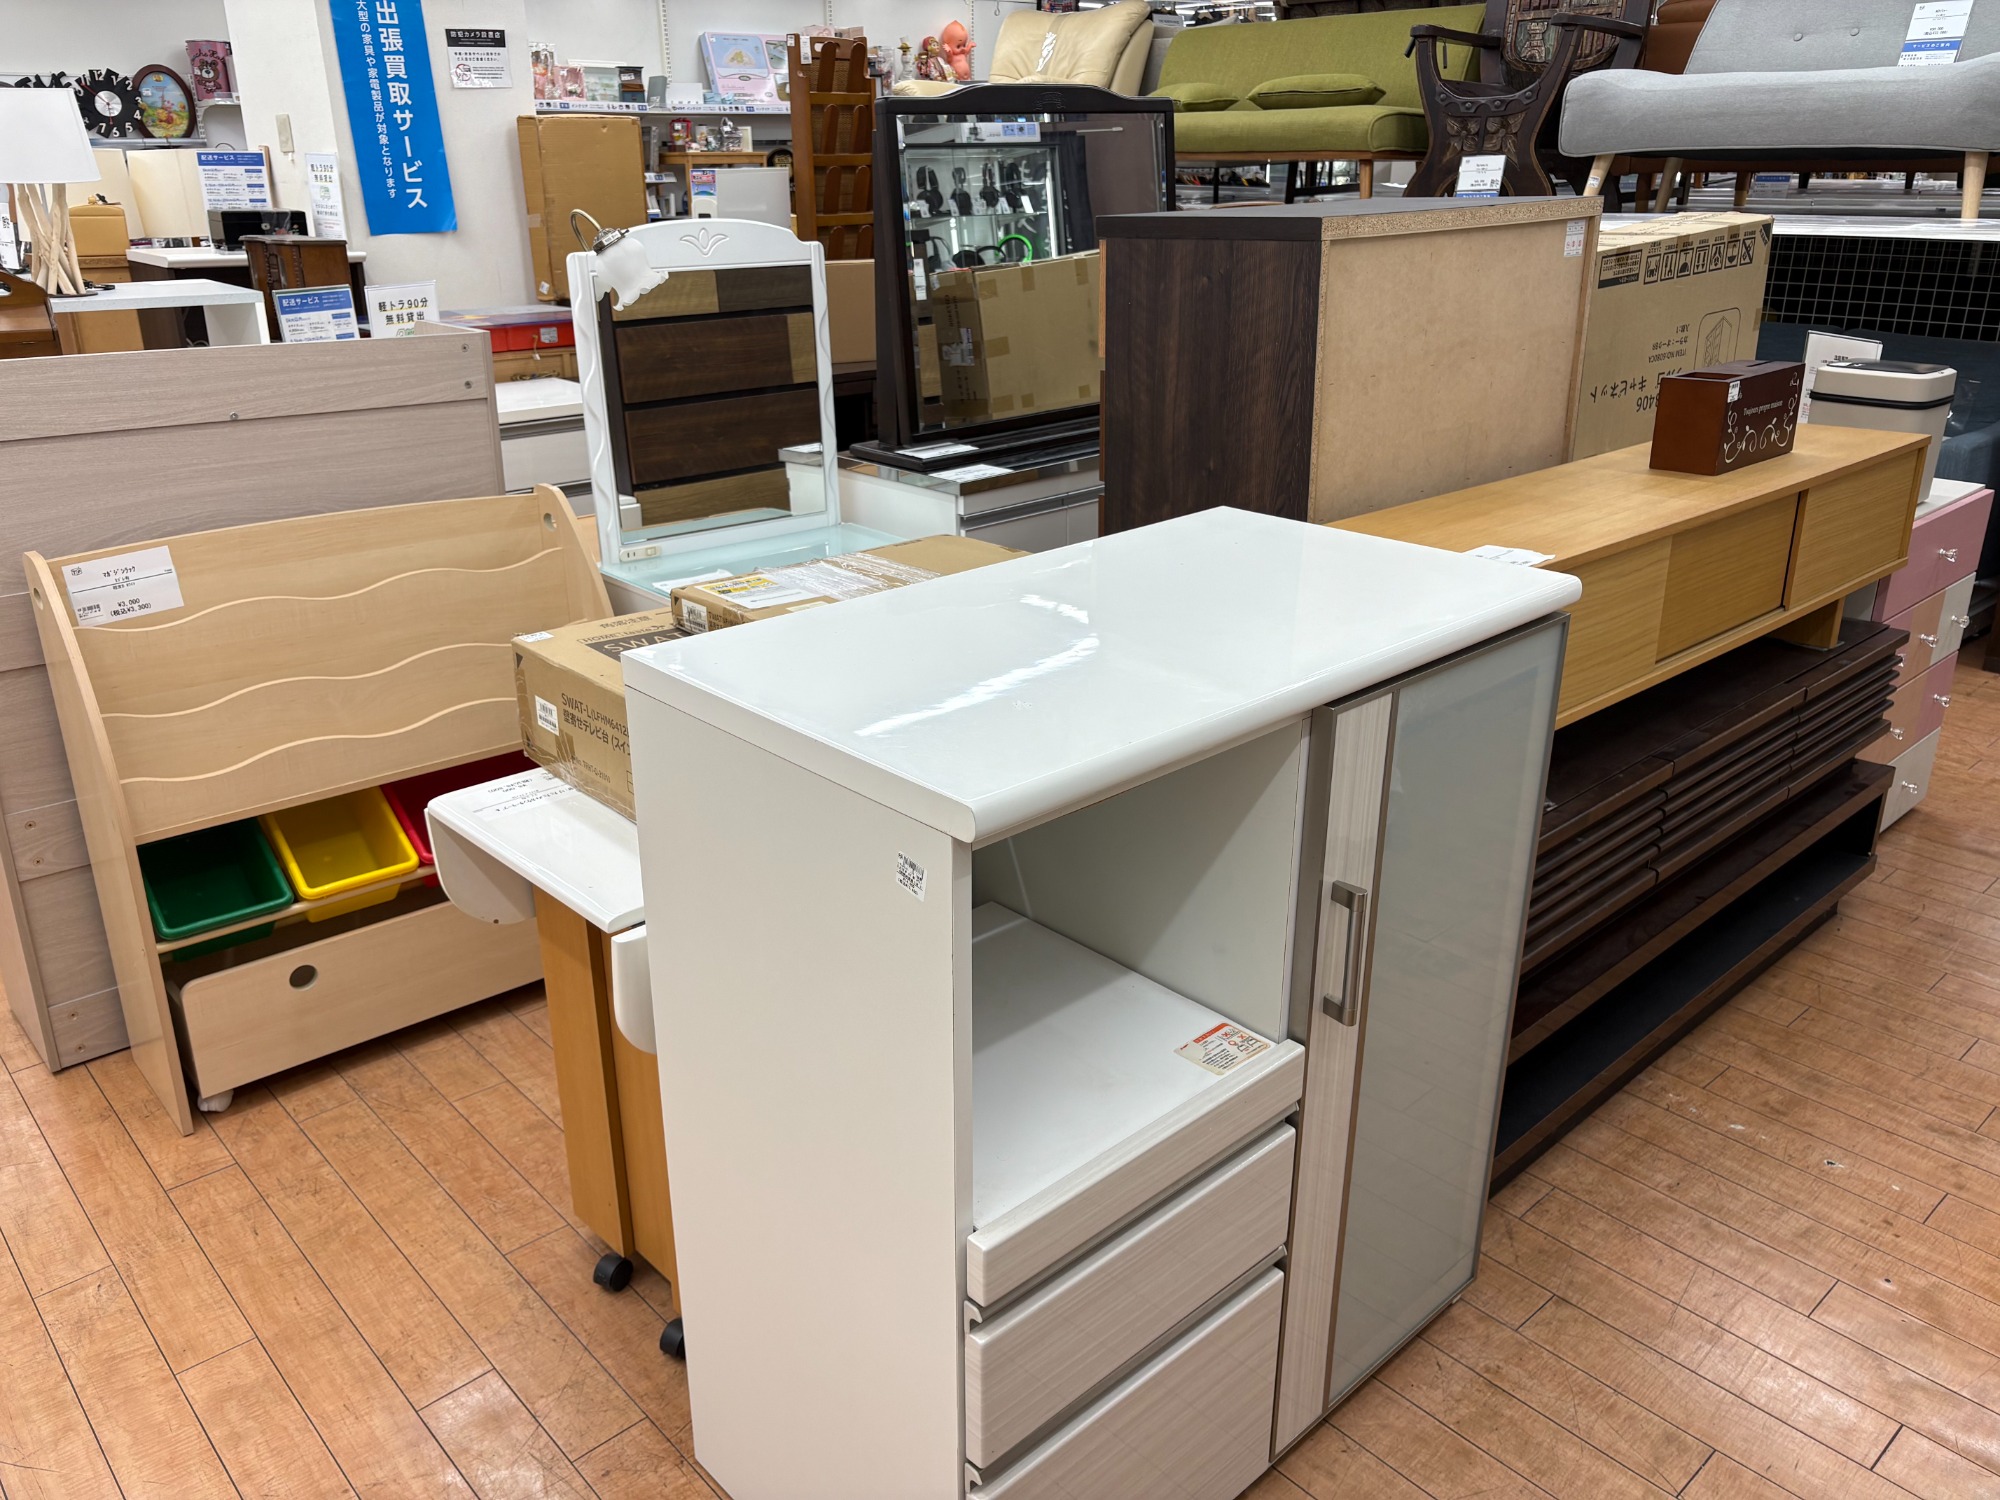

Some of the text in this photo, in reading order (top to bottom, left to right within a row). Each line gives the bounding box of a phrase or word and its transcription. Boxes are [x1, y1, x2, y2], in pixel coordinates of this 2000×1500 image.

[450, 31, 501, 39] 防犯カメラ設置店
[355, 1, 397, 199] 大型の家具や家電製品が対象となります
[375, 0, 428, 209] 出張買取サービス
[282, 296, 320, 307] 配送サービス
[378, 297, 429, 312] 軽トラ90分
[385, 311, 425, 325] 無料貸出
[1590, 375, 1647, 403] キャビネット
[117, 597, 141, 607] ¥3,000
[603, 631, 686, 653] SWAT
[561, 692, 629, 738] SWAT-L(LFHM6412
